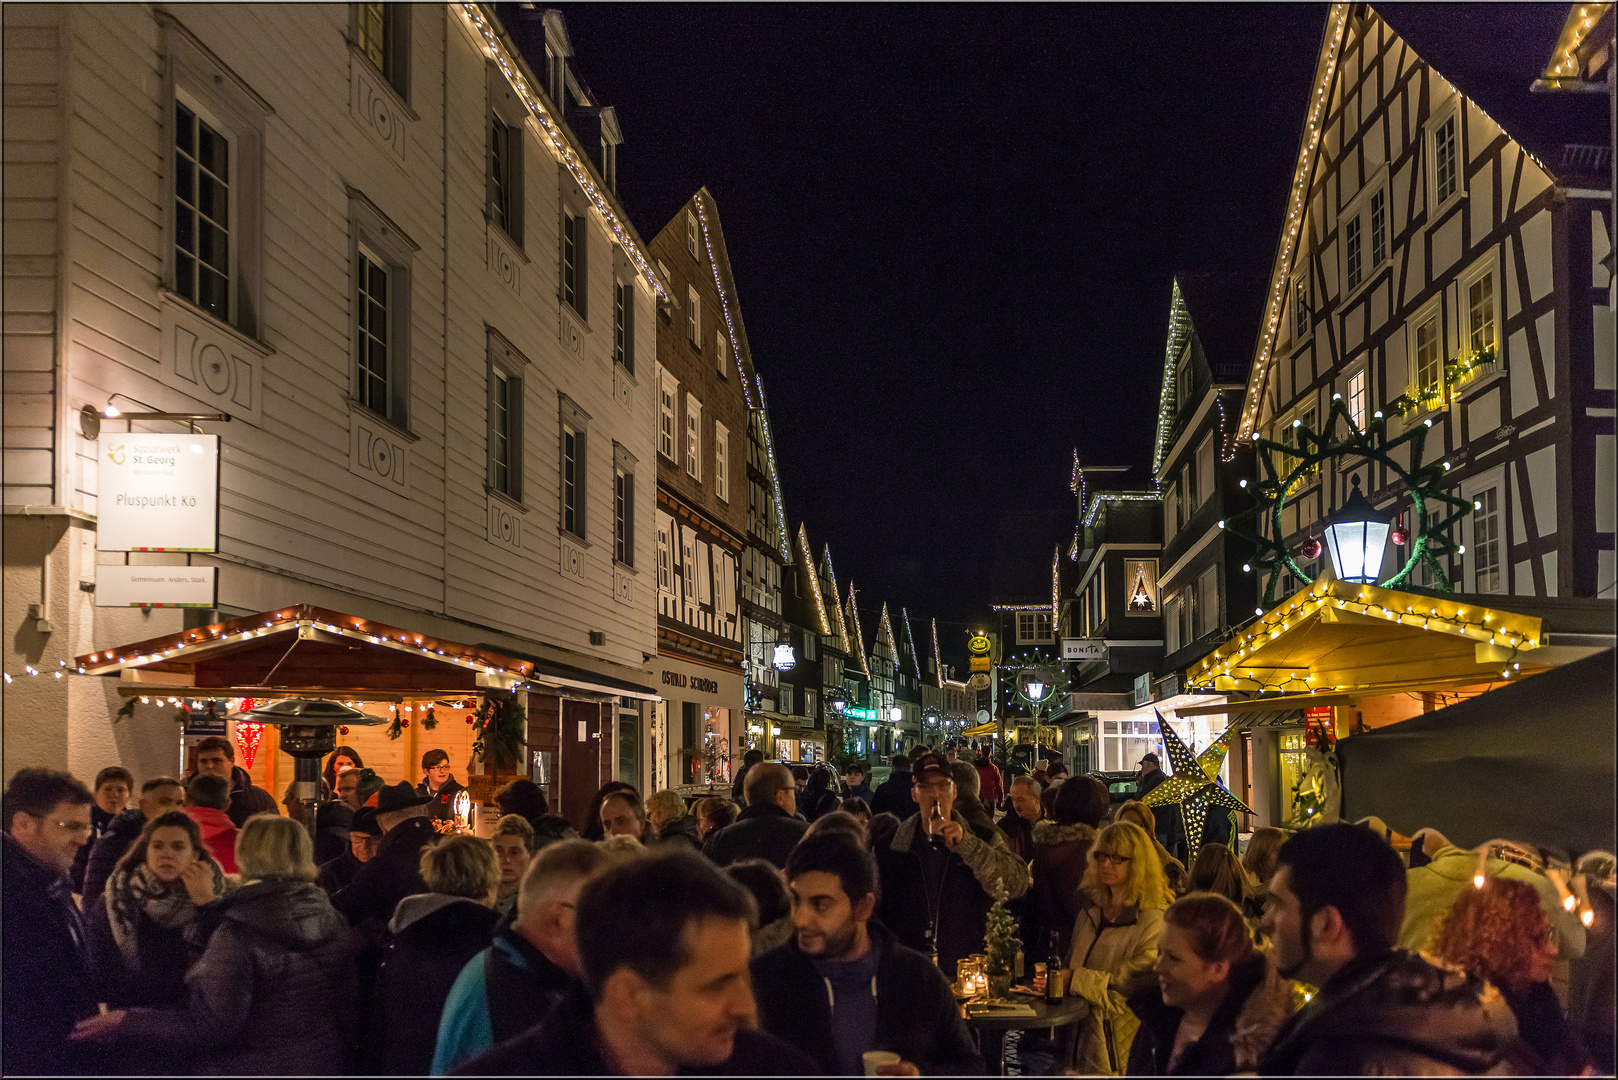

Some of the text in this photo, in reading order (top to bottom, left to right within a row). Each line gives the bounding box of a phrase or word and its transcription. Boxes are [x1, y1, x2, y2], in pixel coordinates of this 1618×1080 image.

[133, 444, 181, 454] Sozialwerk
[133, 455, 175, 467] St. Georg
[116, 493, 196, 509] Pluspunkt Kö
[1067, 644, 1099, 654] BONITA
[661, 670, 718, 694] OSWALD SCHRÖDER
